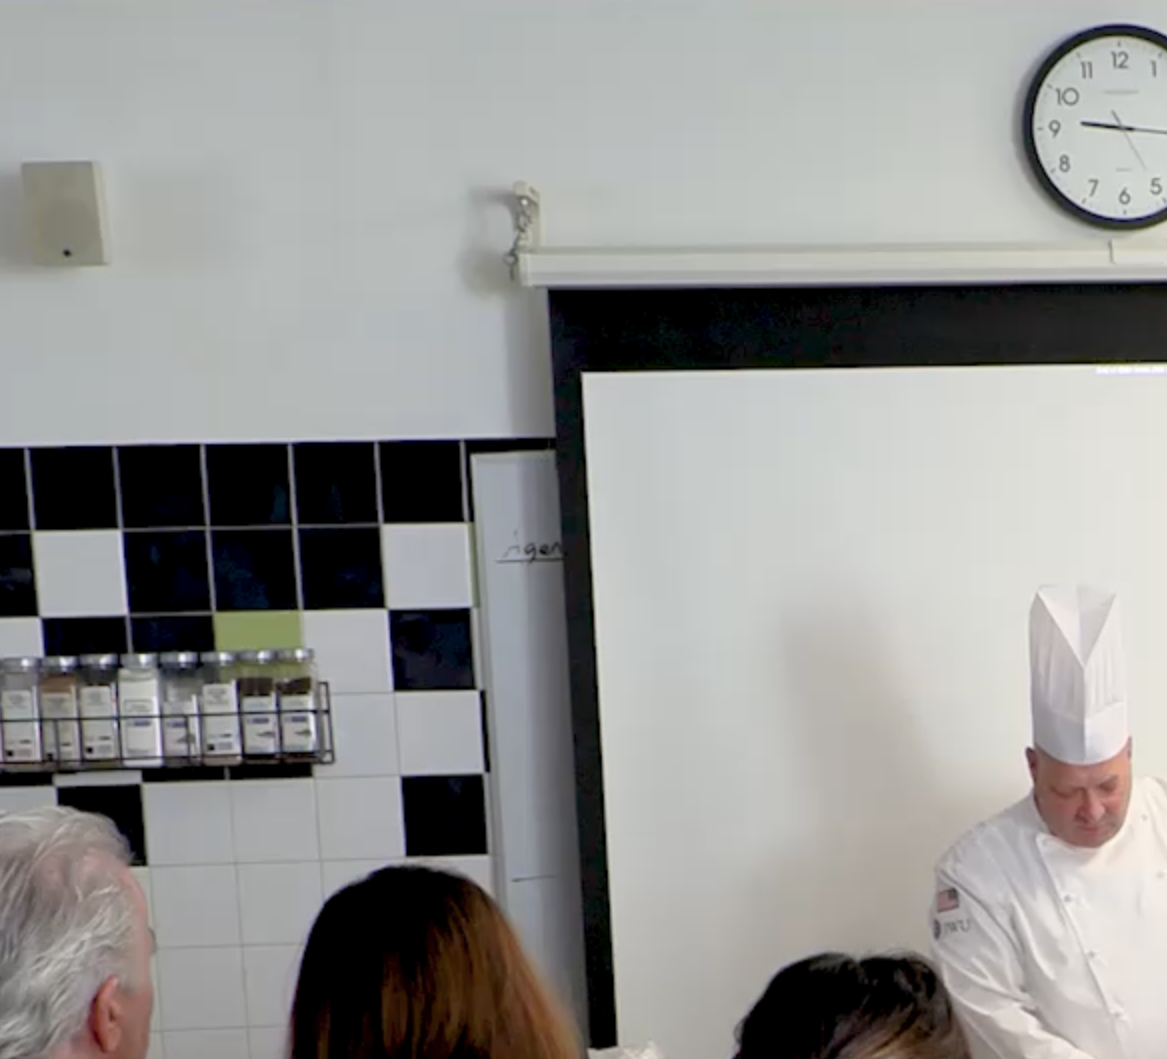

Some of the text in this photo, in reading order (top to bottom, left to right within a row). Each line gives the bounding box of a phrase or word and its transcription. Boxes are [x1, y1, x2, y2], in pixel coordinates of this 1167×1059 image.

[1111, 51, 1129, 69] 12
[1151, 61, 1157, 77] 1
[1081, 61, 1093, 79] 11
[1056, 88, 1080, 106] 10
[1048, 120, 1061, 138] 9
[1058, 154, 1071, 173] 8
[1087, 179, 1099, 198] 7
[1149, 177, 1163, 196] 5
[1118, 189, 1131, 205] 6
